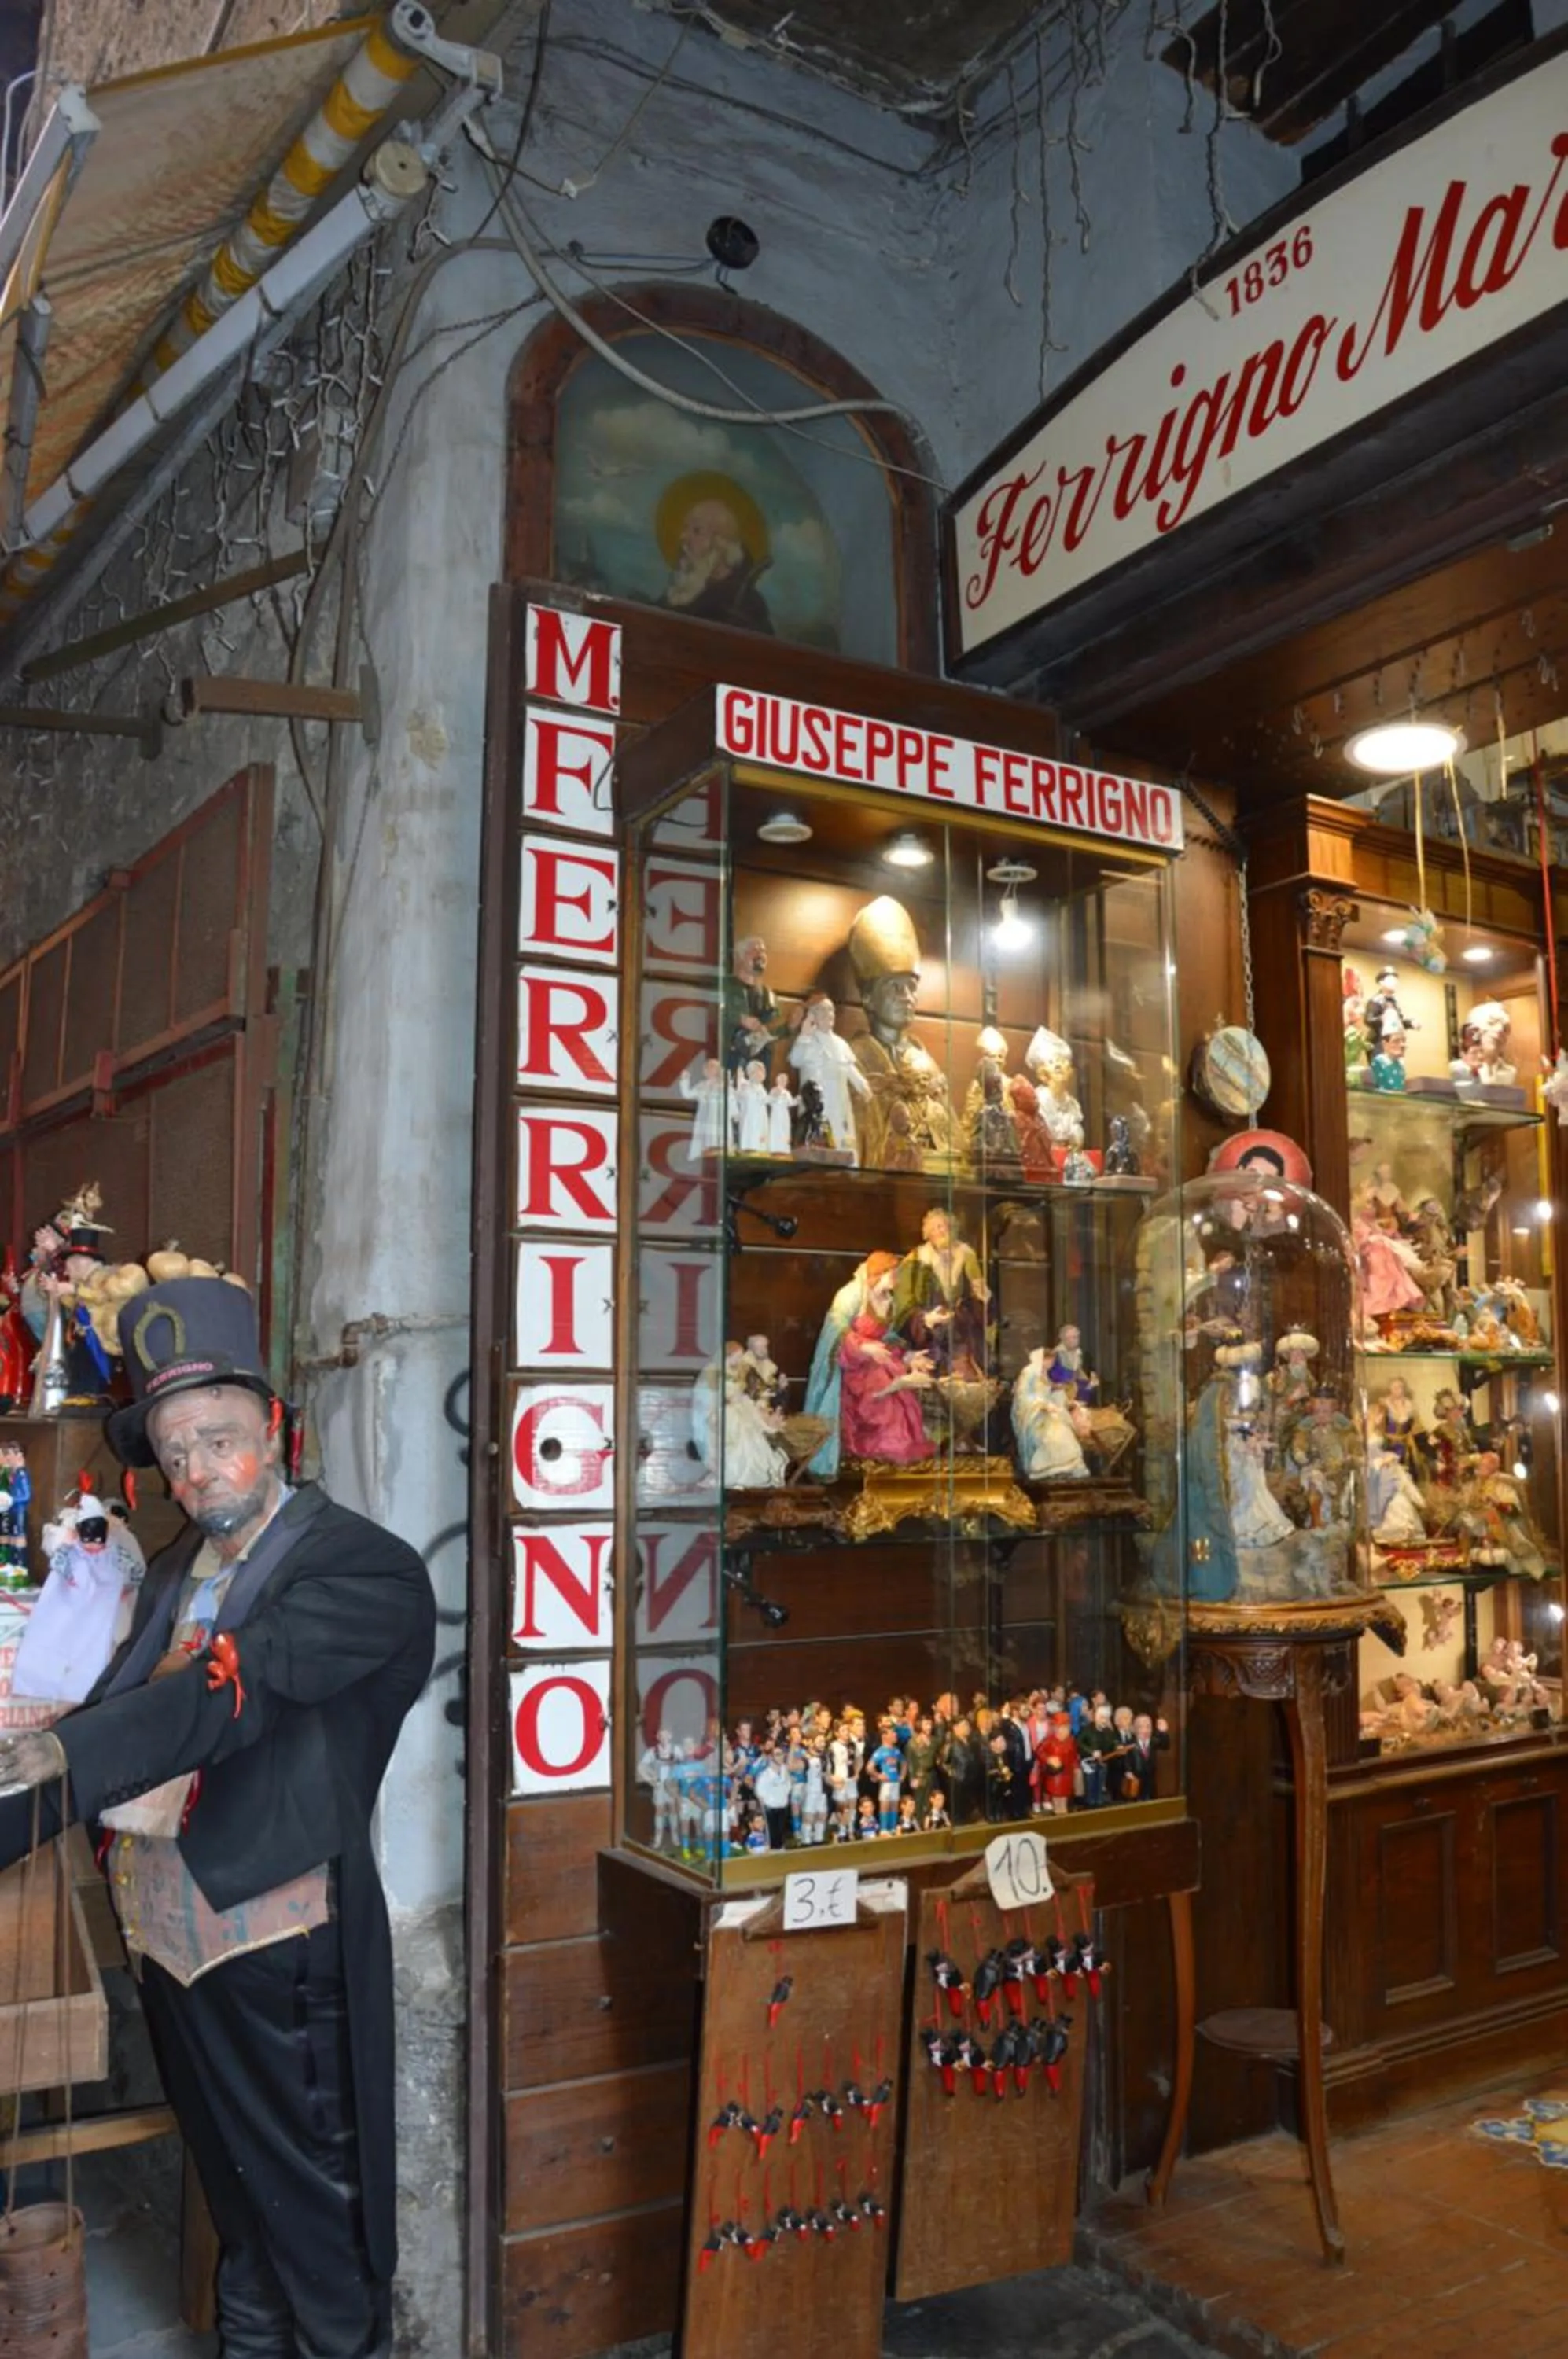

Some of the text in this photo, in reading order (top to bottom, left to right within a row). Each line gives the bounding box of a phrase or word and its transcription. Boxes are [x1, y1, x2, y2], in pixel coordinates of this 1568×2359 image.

[1225, 226, 1313, 317] 1836
[966, 315, 1336, 610] Ferrigno
[723, 690, 1173, 845] GIUSEPPE FERRIGNO
[515, 719, 617, 1779] FERRIGNO
